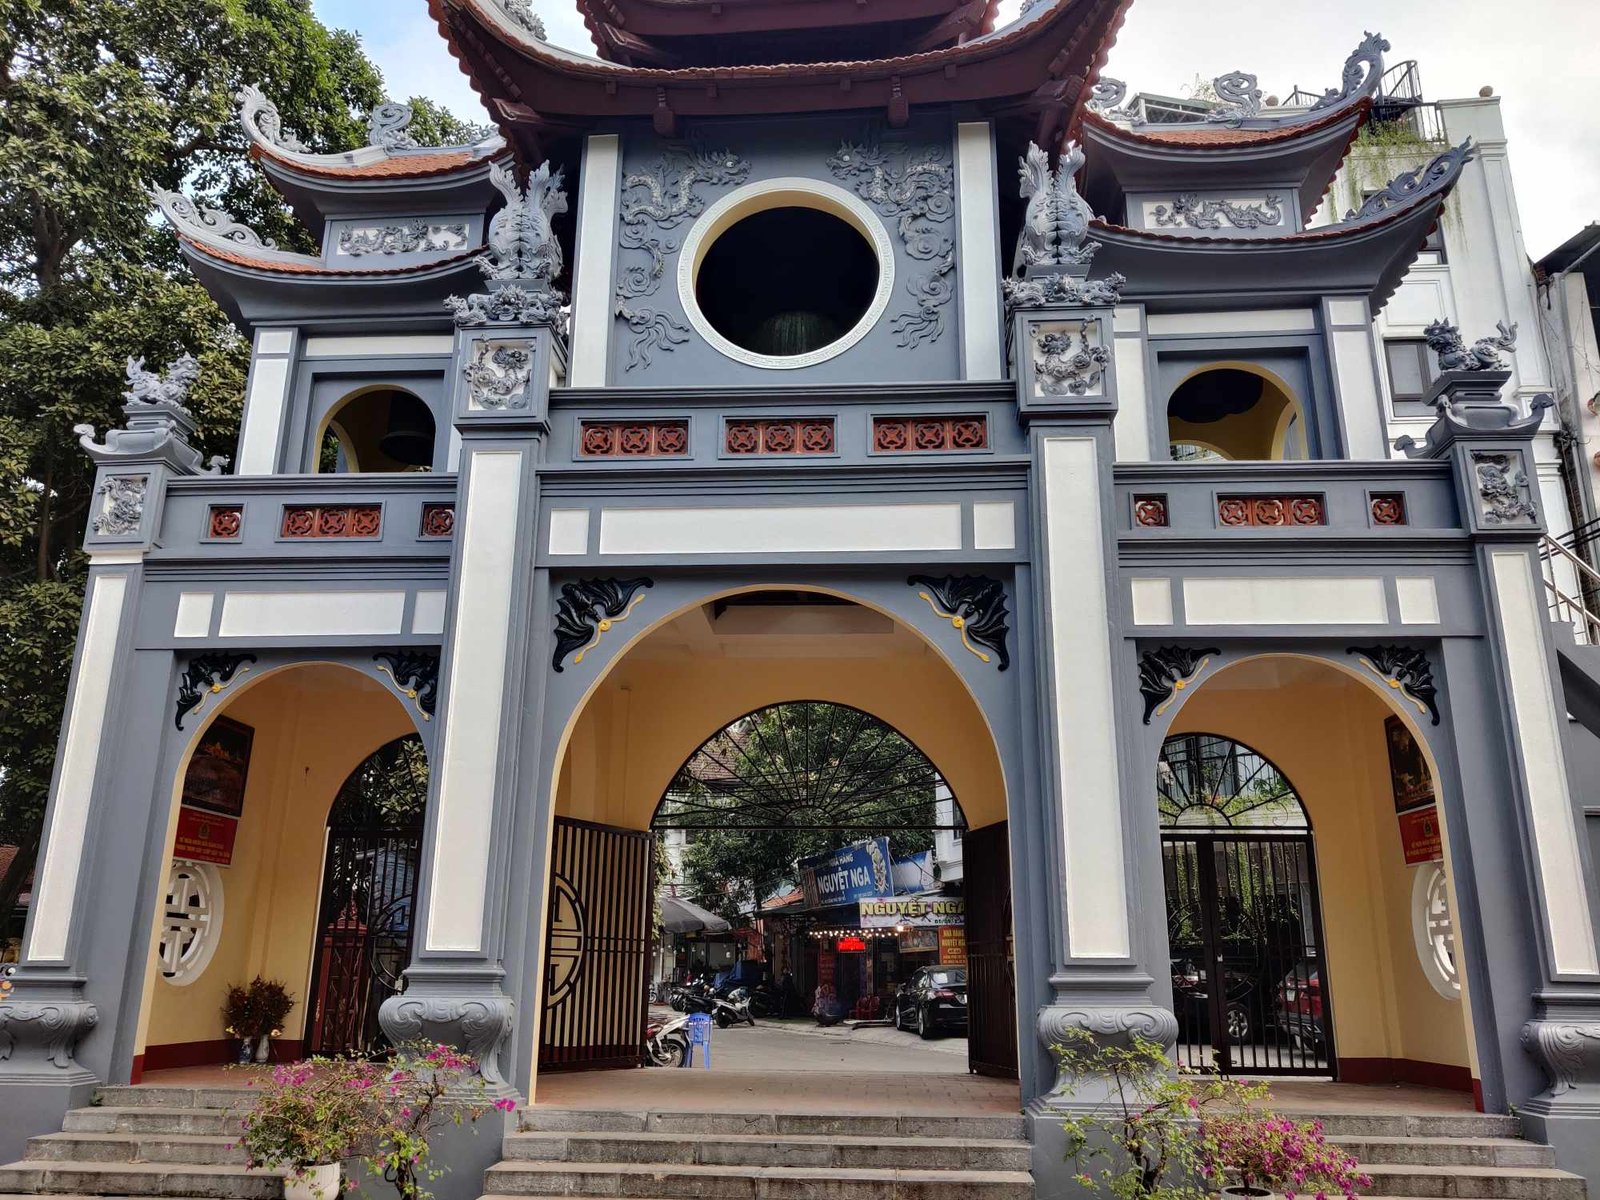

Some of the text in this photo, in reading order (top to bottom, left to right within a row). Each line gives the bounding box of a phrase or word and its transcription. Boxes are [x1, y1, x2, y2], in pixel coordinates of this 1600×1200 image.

[817, 865, 871, 894] NGUYỆT NGA
[861, 897, 928, 916] NGUYỆT
